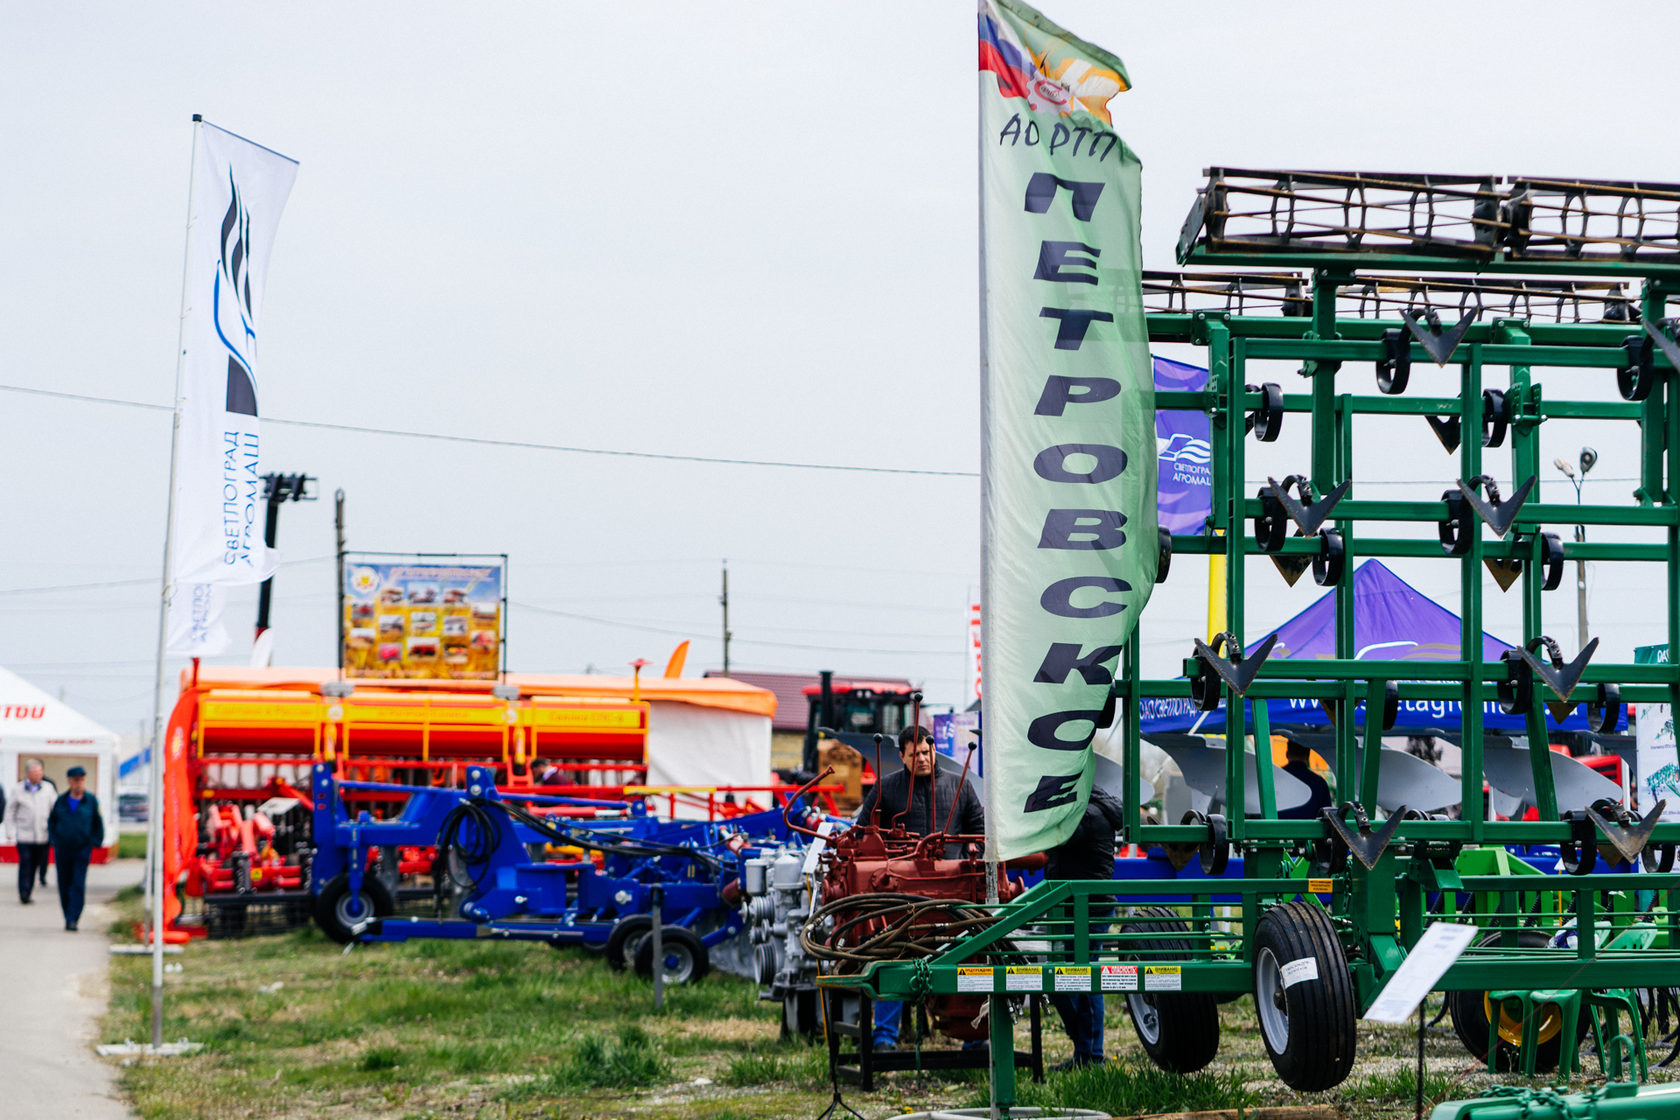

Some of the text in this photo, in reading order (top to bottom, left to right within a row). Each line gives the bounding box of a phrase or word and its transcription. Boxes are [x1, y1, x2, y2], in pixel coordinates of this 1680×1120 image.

[1000, 113, 1118, 162] АО РТП
[223, 431, 240, 566] СВЕТЛОГРАД
[1024, 172, 1132, 813] ПЕТРОВСКОЕ
[1173, 462, 1211, 480] СВЕТЛОГРА
